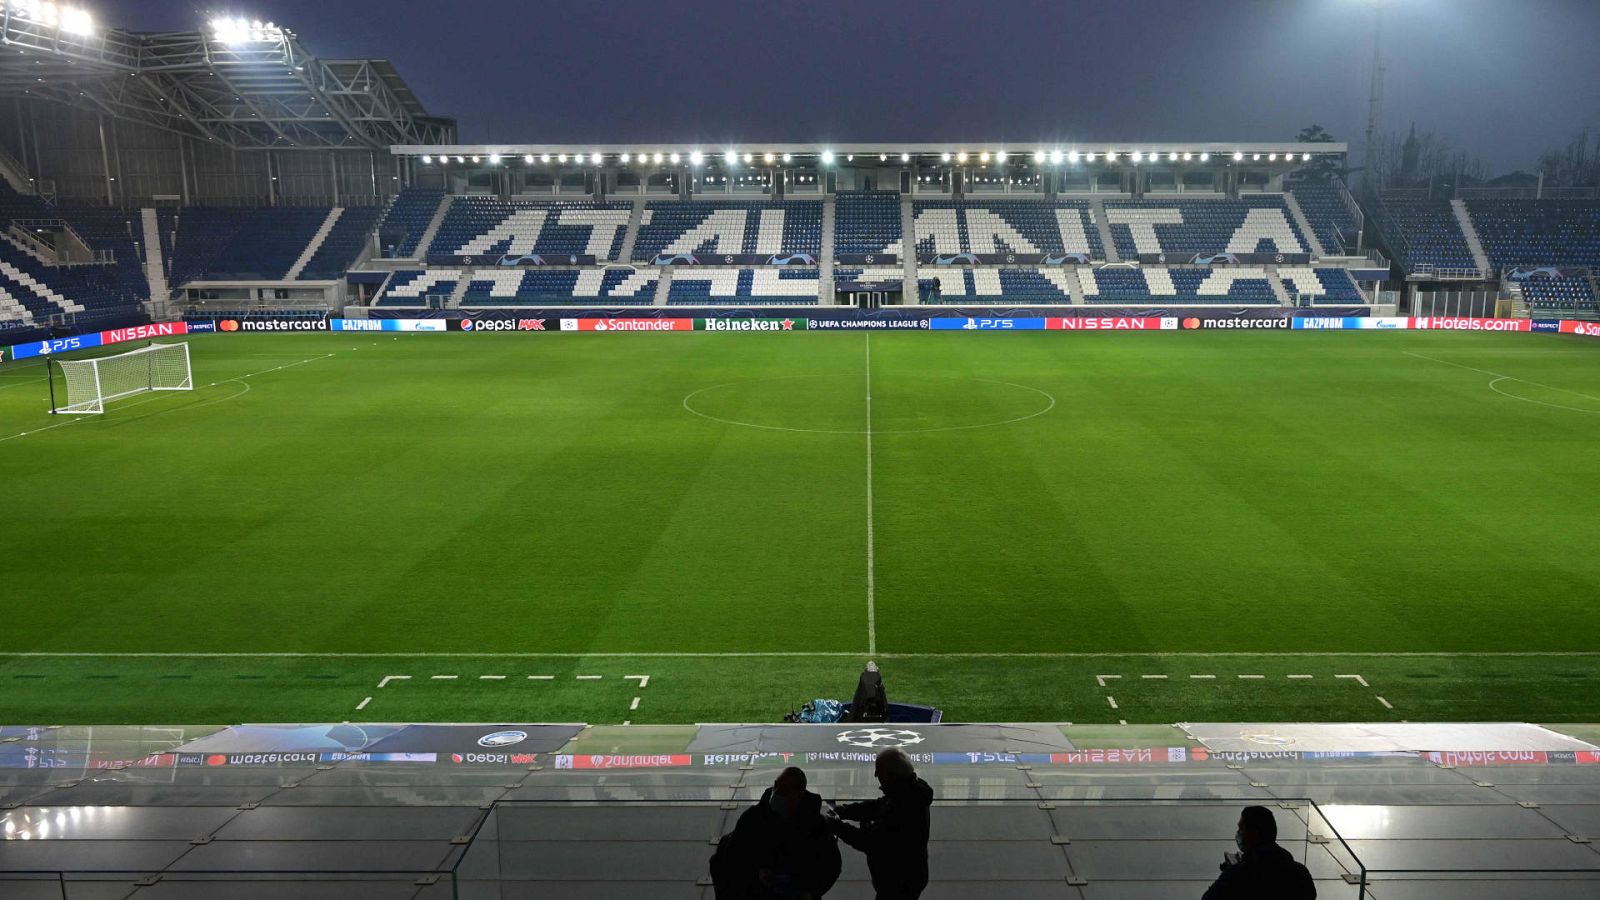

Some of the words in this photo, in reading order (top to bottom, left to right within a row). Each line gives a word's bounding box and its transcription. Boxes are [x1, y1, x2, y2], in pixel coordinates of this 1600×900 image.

[242, 317, 327, 331] mastercard
[342, 319, 382, 331] GAZPROM
[475, 319, 516, 331] pepsi
[518, 319, 546, 331] MAX
[608, 319, 676, 331] Santander
[705, 318, 780, 331] Heineken
[819, 320, 840, 328] UEFA
[841, 320, 887, 328] CHAMPIONS
[888, 320, 918, 328] LEAGUE
[981, 319, 1014, 328] PS5
[1062, 318, 1145, 329] NISSAN
[1203, 317, 1288, 329] mastercard
[1303, 318, 1343, 329] GAZPROM
[110, 323, 173, 342] NISSAN
[53, 337, 81, 351] PS5
